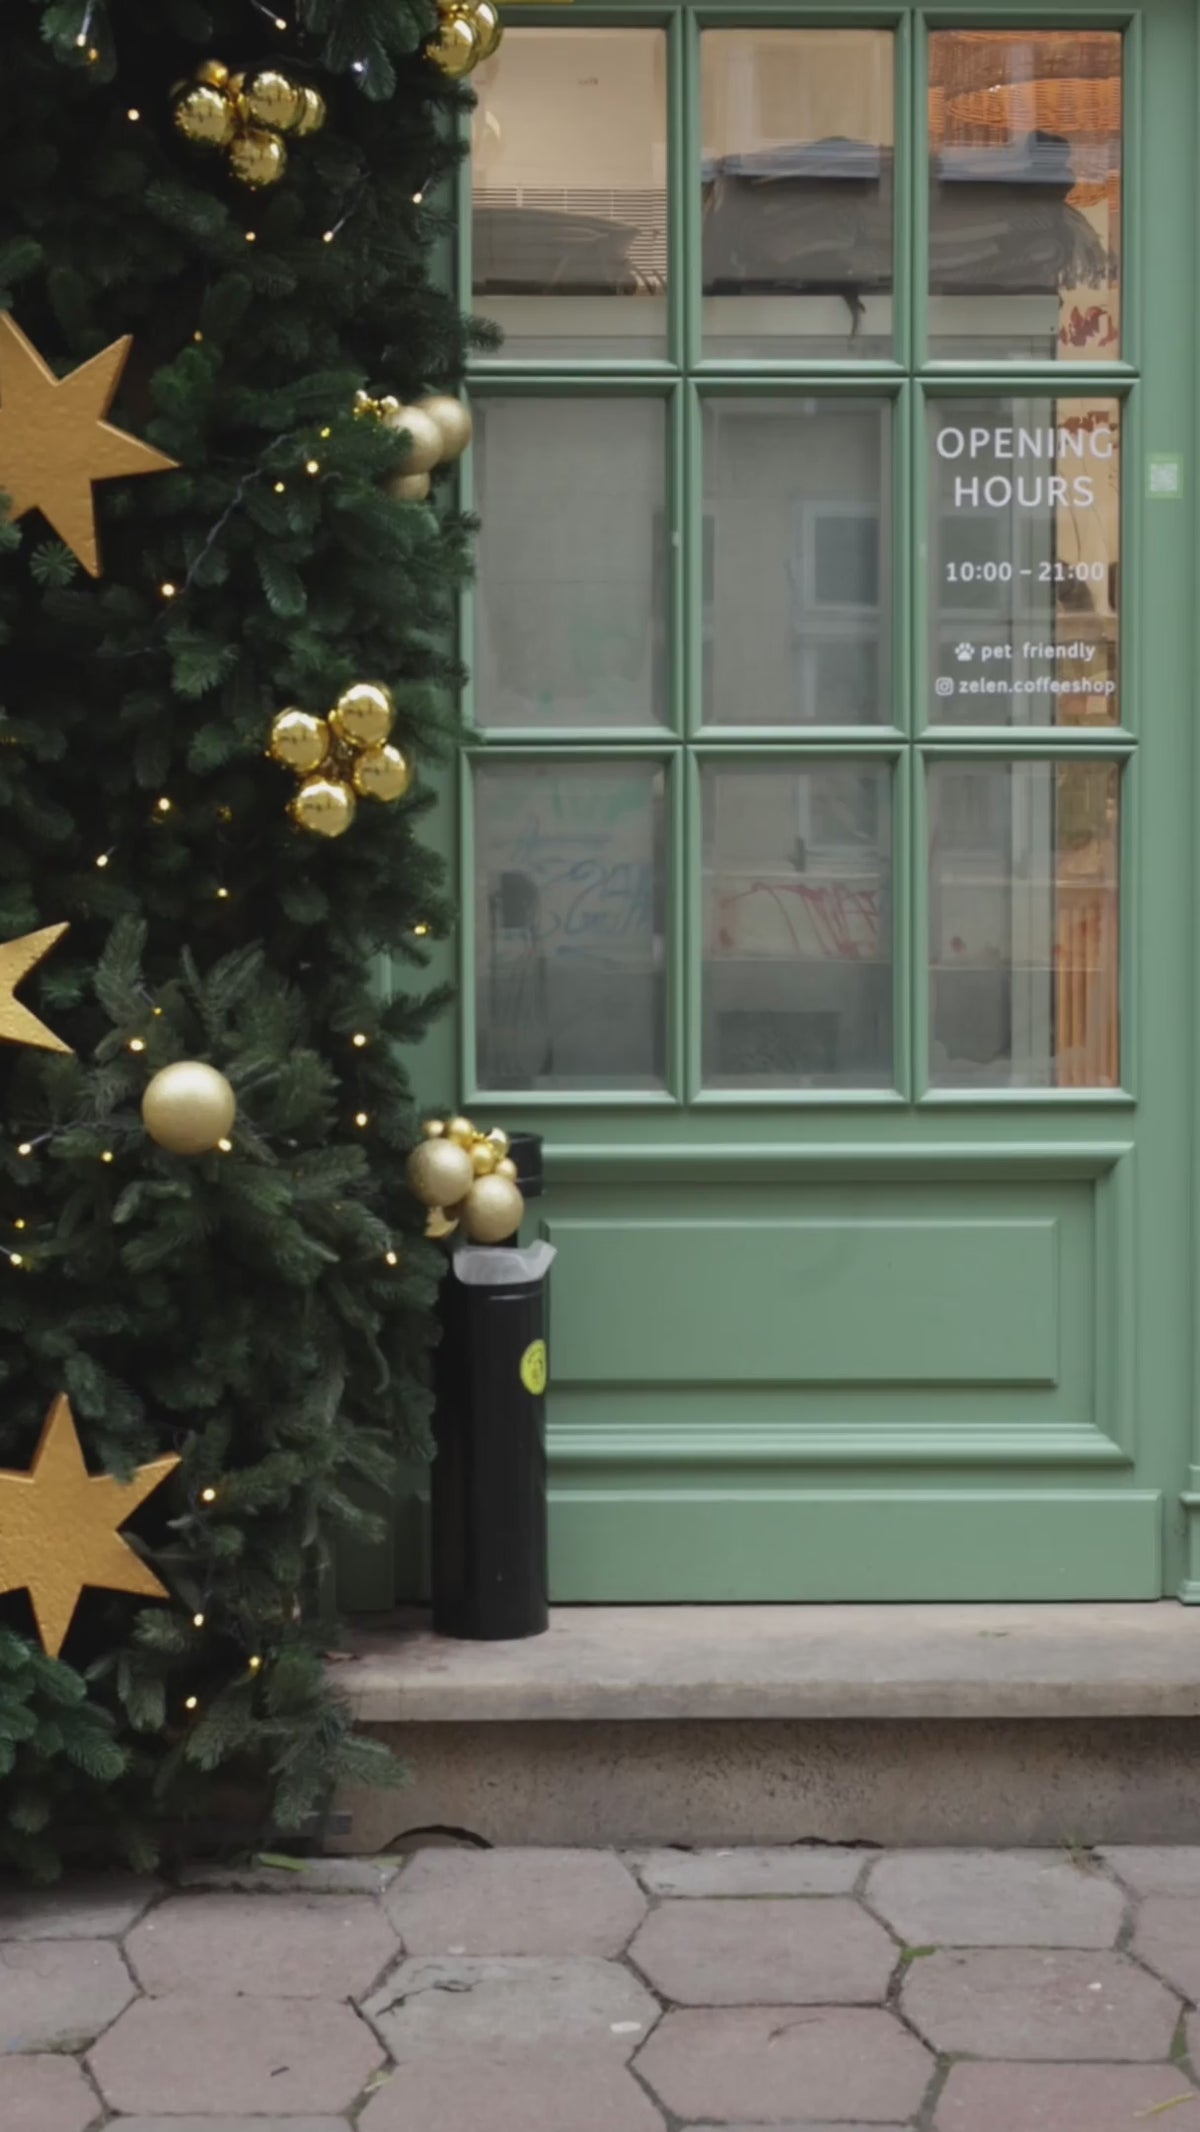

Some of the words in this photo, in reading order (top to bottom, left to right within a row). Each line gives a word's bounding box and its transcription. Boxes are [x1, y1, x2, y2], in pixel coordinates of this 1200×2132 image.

[936, 427, 1113, 459] OPENING
[954, 475, 1095, 507] HOURS
[946, 562, 1012, 581] 10:00
[1038, 562, 1105, 581] 21:00
[981, 643, 1012, 662] pet
[1022, 642, 1096, 661] friendly
[959, 677, 1116, 695] zelen.coffeeshop
